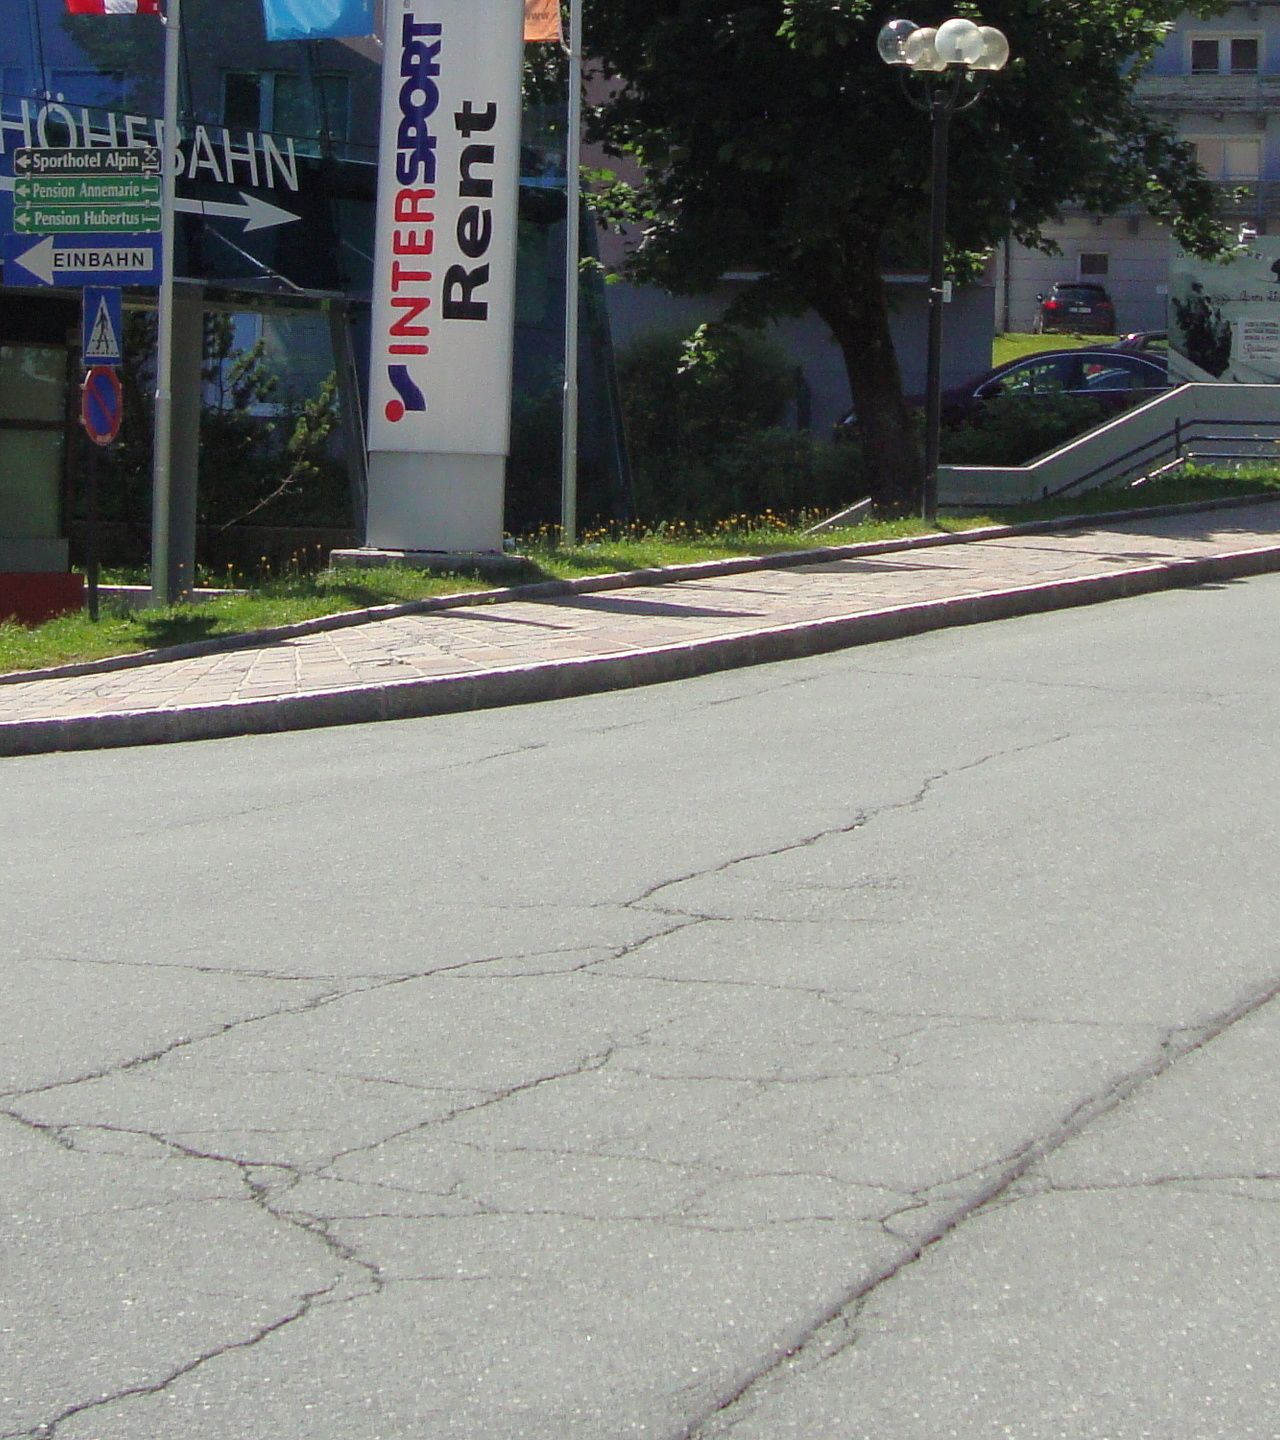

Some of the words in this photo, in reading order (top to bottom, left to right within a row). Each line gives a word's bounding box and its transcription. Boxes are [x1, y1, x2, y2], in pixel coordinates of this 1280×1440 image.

[32, 152, 101, 172] Sporthotel
[105, 152, 139, 171] Alpin
[33, 182, 75, 197] Pension
[80, 181, 140, 197] Annemarie
[388, 13, 442, 355] INTERSPORT
[34, 210, 80, 225] Pension
[84, 210, 140, 225] Hubertus
[442, 100, 497, 321] Rent
[53, 252, 144, 268] EINBAHN
